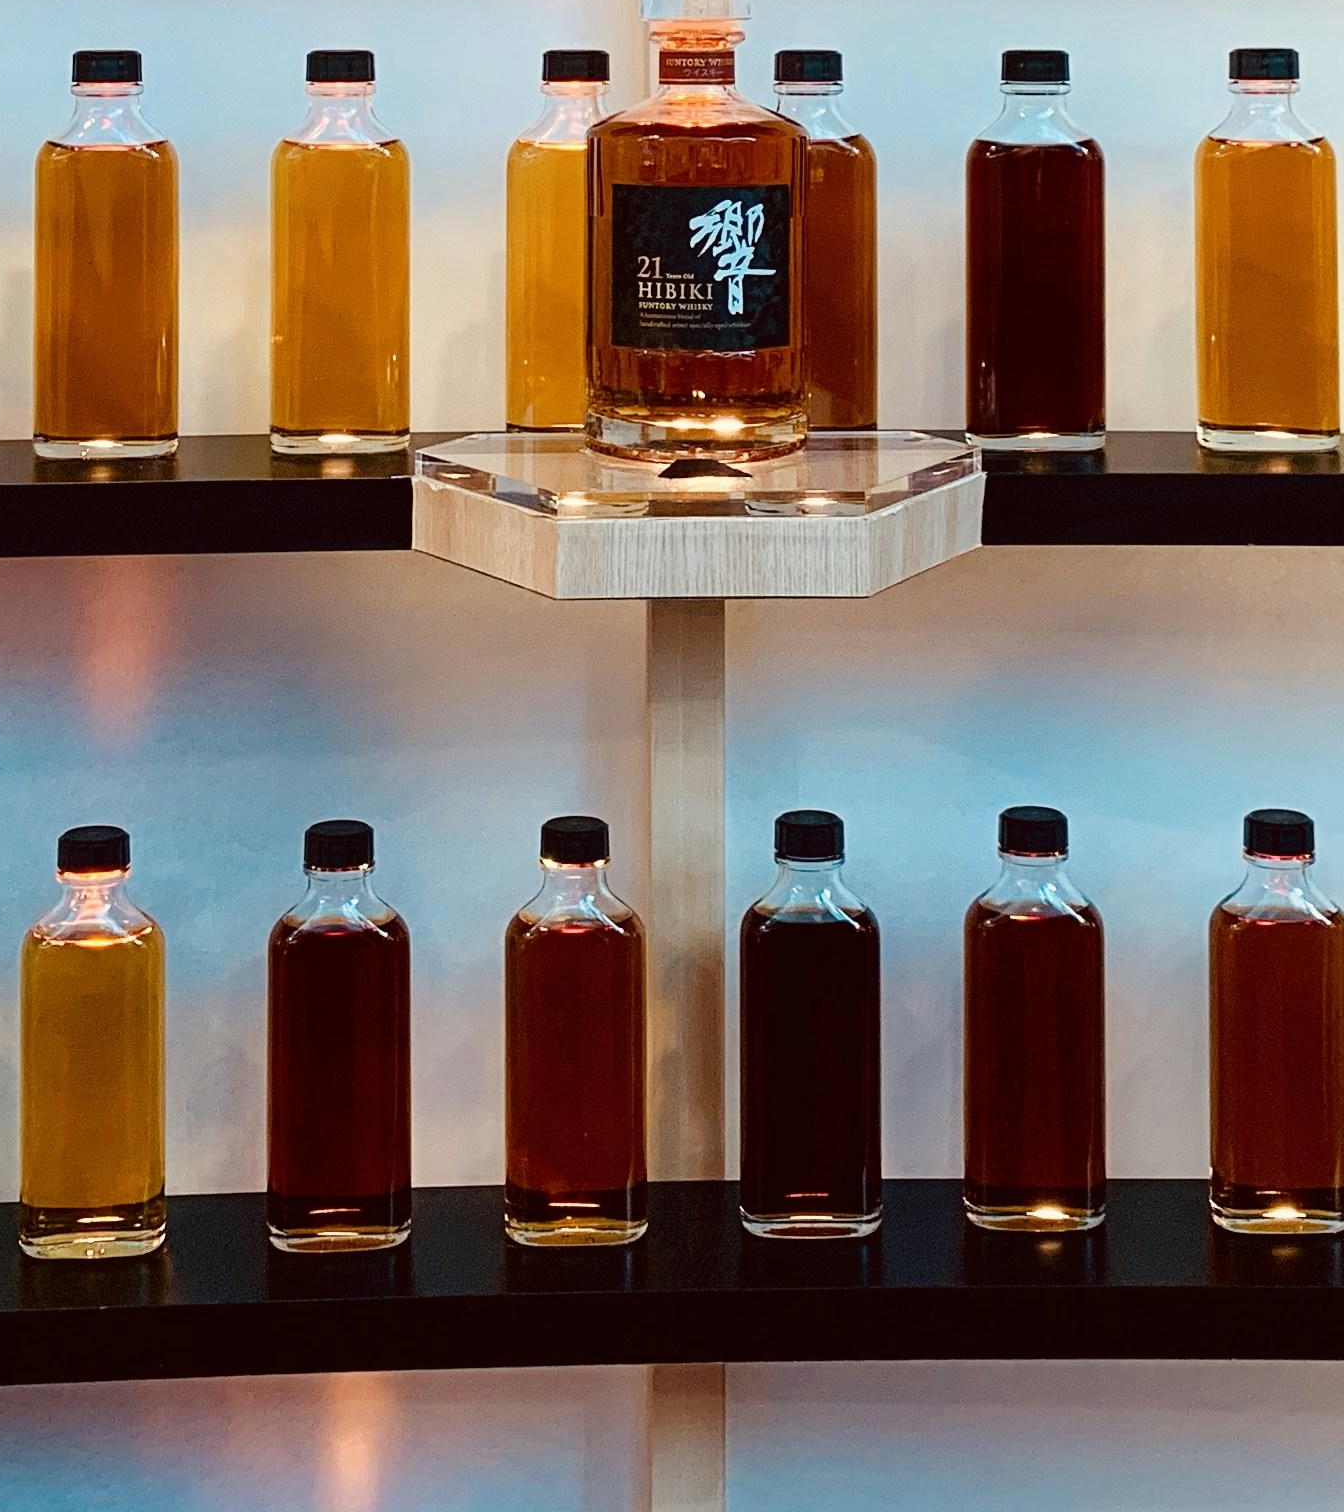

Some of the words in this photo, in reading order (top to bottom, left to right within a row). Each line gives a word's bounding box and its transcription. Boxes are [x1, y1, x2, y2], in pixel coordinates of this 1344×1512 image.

[665, 58, 706, 67] SUNTORY
[688, 199, 777, 315] 響
[636, 255, 664, 279] 21
[665, 272, 682, 280] Years
[682, 272, 695, 280] Old
[637, 281, 714, 300] HIBIKI
[638, 301, 677, 310] SUNTORY
[678, 302, 714, 311] WHISKY
